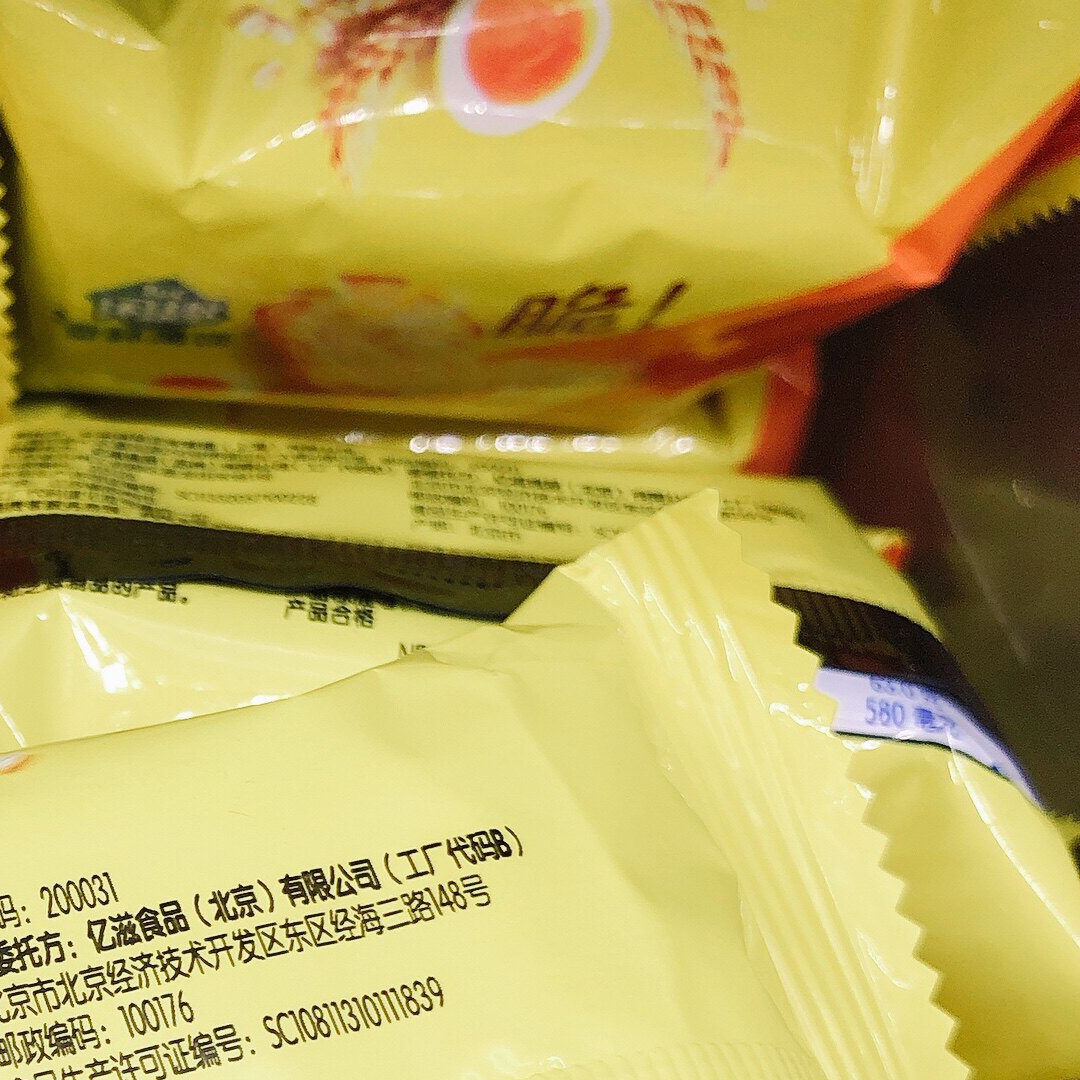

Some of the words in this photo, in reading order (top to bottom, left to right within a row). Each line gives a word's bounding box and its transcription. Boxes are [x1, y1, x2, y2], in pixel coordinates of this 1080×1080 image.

[40, 872, 120, 920] 200031
[118, 990, 195, 1039] 100176
[262, 976, 445, 1050] SC10811310111839
